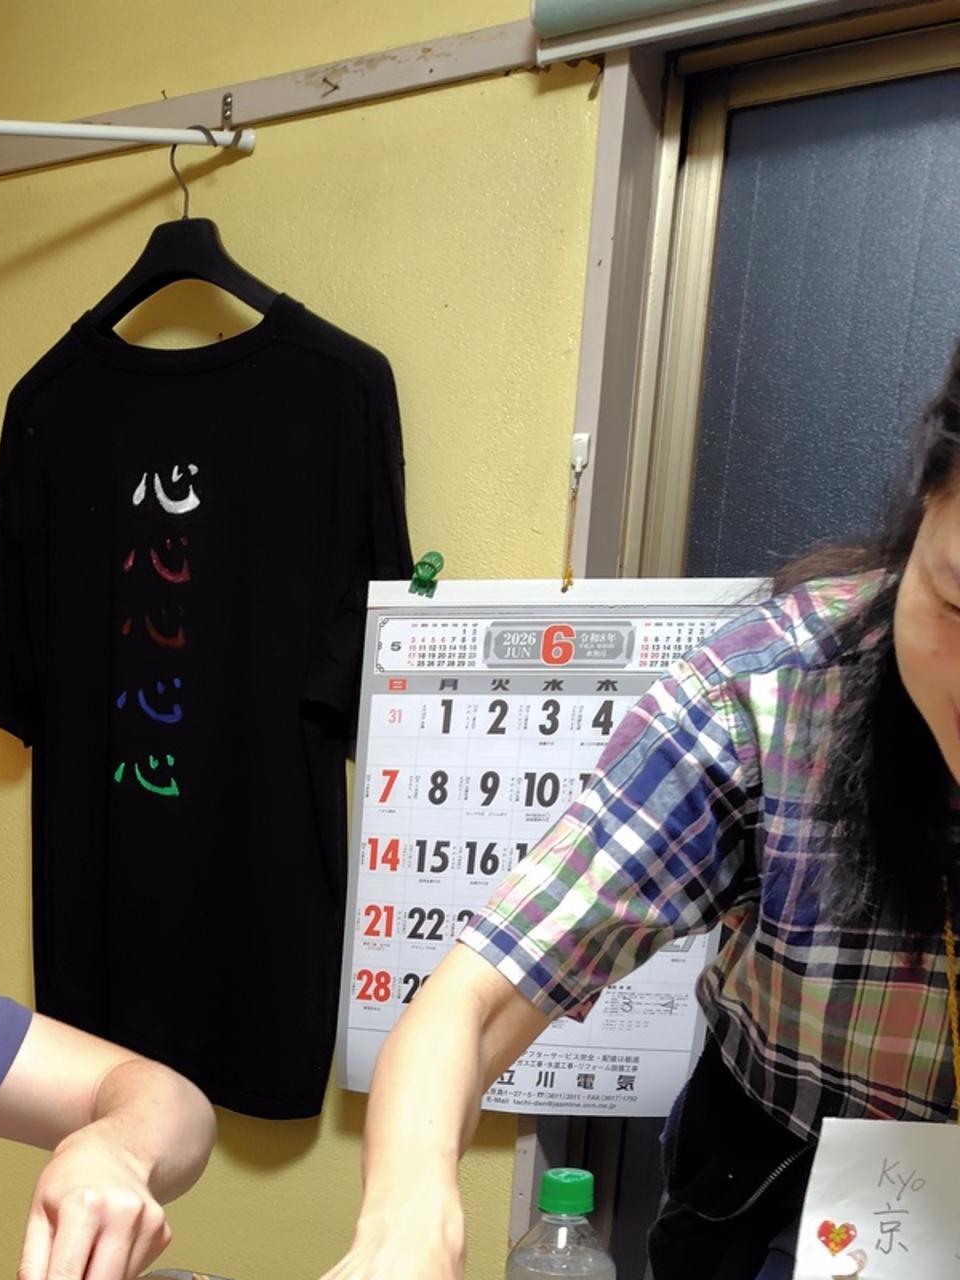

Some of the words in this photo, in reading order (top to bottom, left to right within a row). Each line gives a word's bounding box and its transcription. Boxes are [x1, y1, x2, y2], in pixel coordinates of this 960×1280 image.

[132, 463, 200, 514] 心
[503, 633, 537, 646] 2026
[504, 647, 531, 658] JUN
[542, 625, 575, 666] 6
[388, 678, 407, 691] 日
[440, 679, 458, 691] 月
[492, 679, 510, 692] 火
[543, 679, 564, 692] 水
[596, 679, 618, 692] 木
[388, 709, 403, 724] 31
[441, 699, 453, 734] 1
[487, 699, 509, 735] 2
[539, 699, 561, 736] 3
[592, 700, 614, 735] 4
[379, 769, 399, 804] 7
[428, 770, 449, 805] 8
[480, 771, 500, 807] 9
[524, 772, 561, 808] 10
[367, 838, 400, 872] 14
[416, 839, 450, 873] 15
[465, 841, 500, 876] 16
[363, 904, 395, 938] 21
[406, 907, 446, 941] 22
[356, 968, 391, 1003] 28
[401, 972, 431, 1004] 2
[877, 1158, 926, 1201] Kyo
